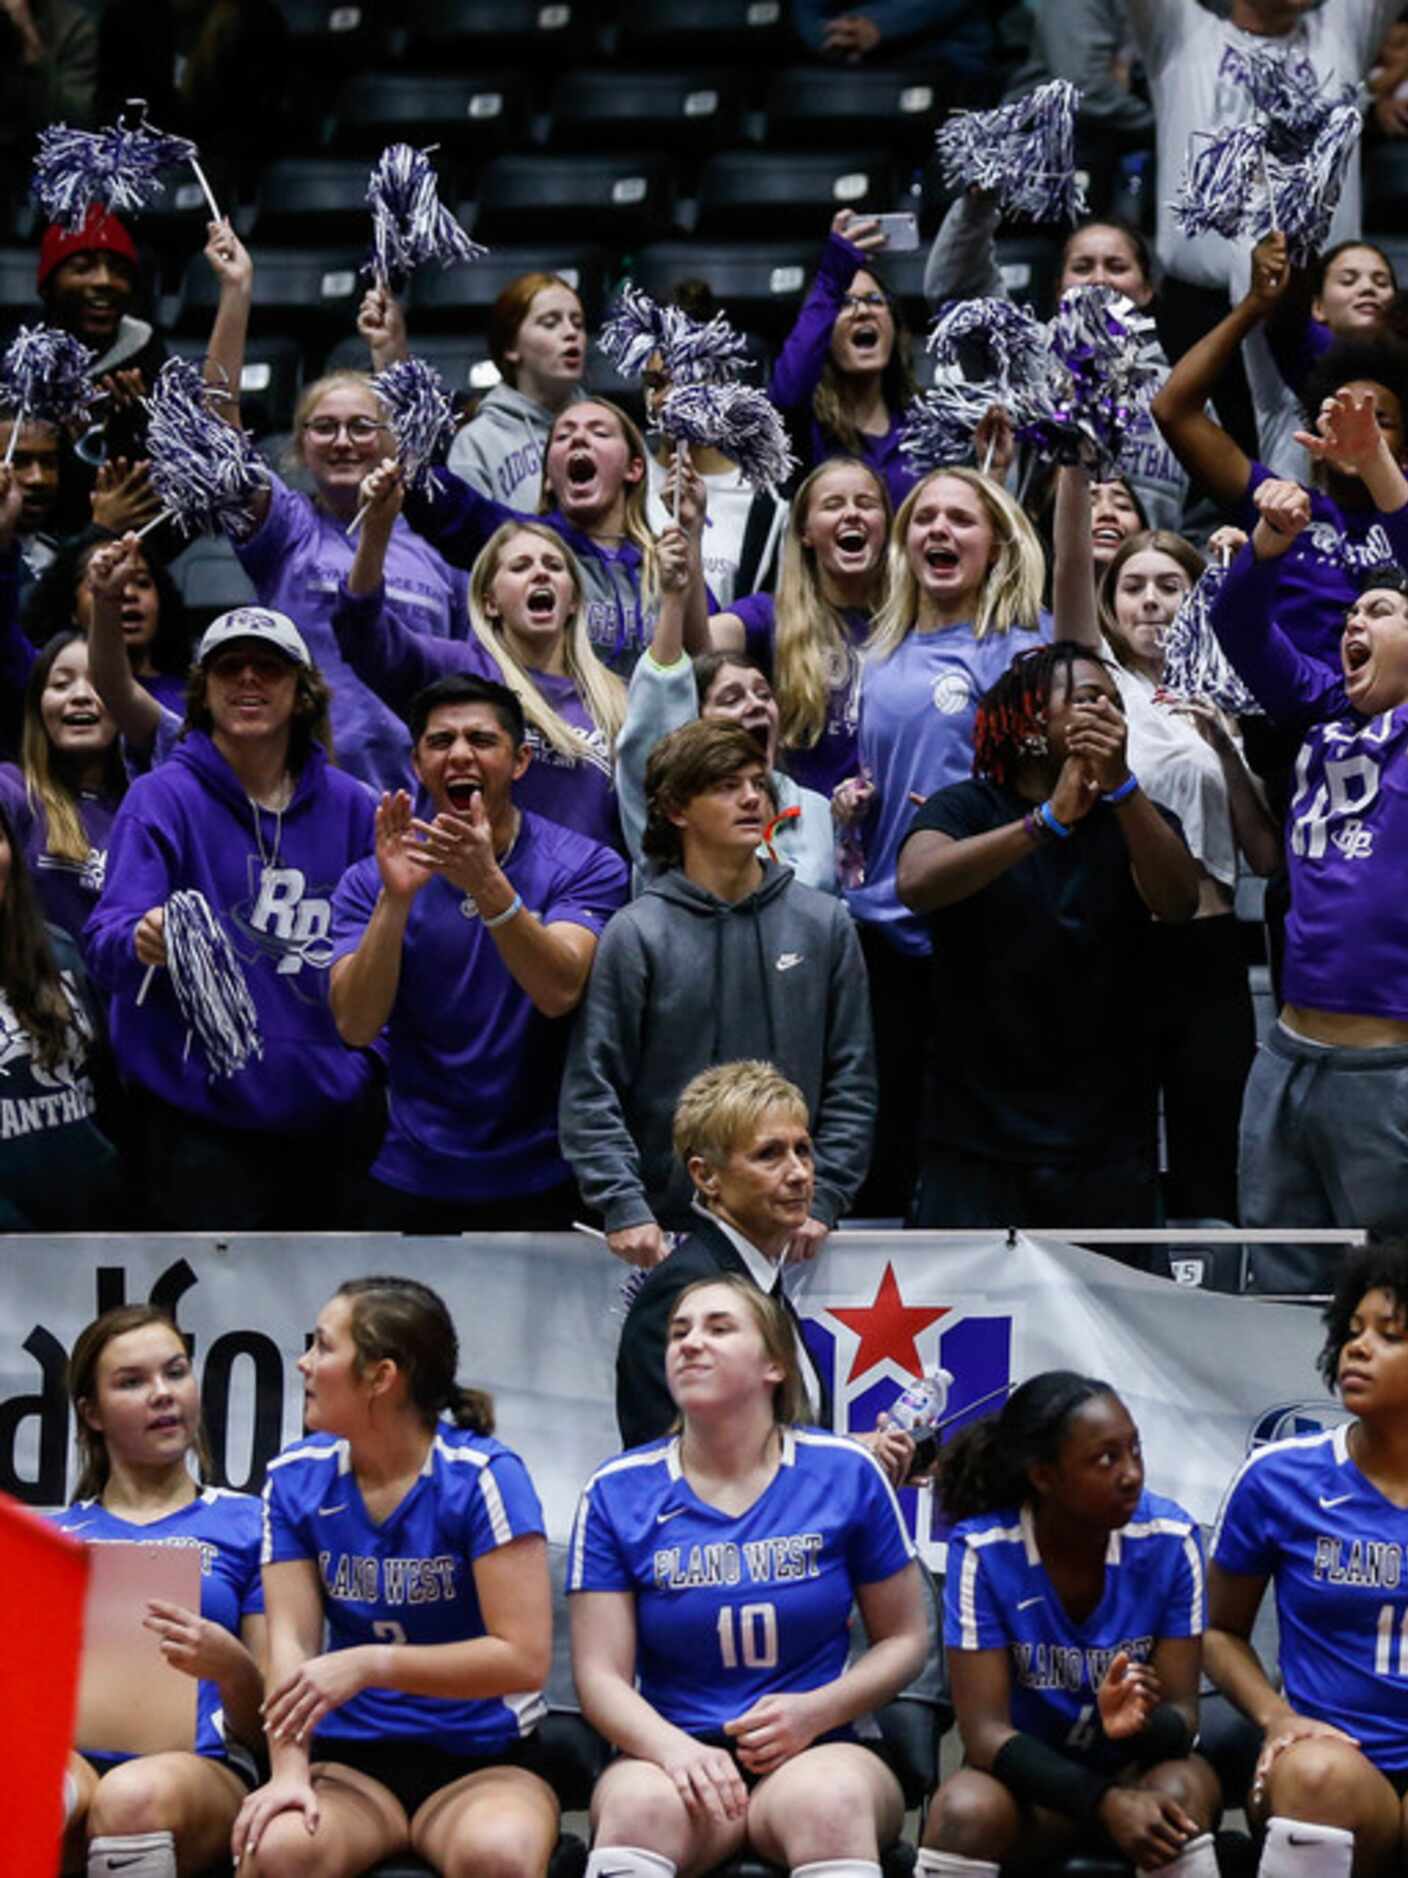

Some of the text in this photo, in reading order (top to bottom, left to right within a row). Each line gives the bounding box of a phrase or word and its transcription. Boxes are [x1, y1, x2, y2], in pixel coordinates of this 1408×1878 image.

[250, 867, 333, 975] RP
[384, 1555, 457, 1605] WEST
[653, 1533, 824, 1589] PLANO WEST
[1313, 1536, 1402, 1589] PLANO
[717, 1602, 778, 1668] 10
